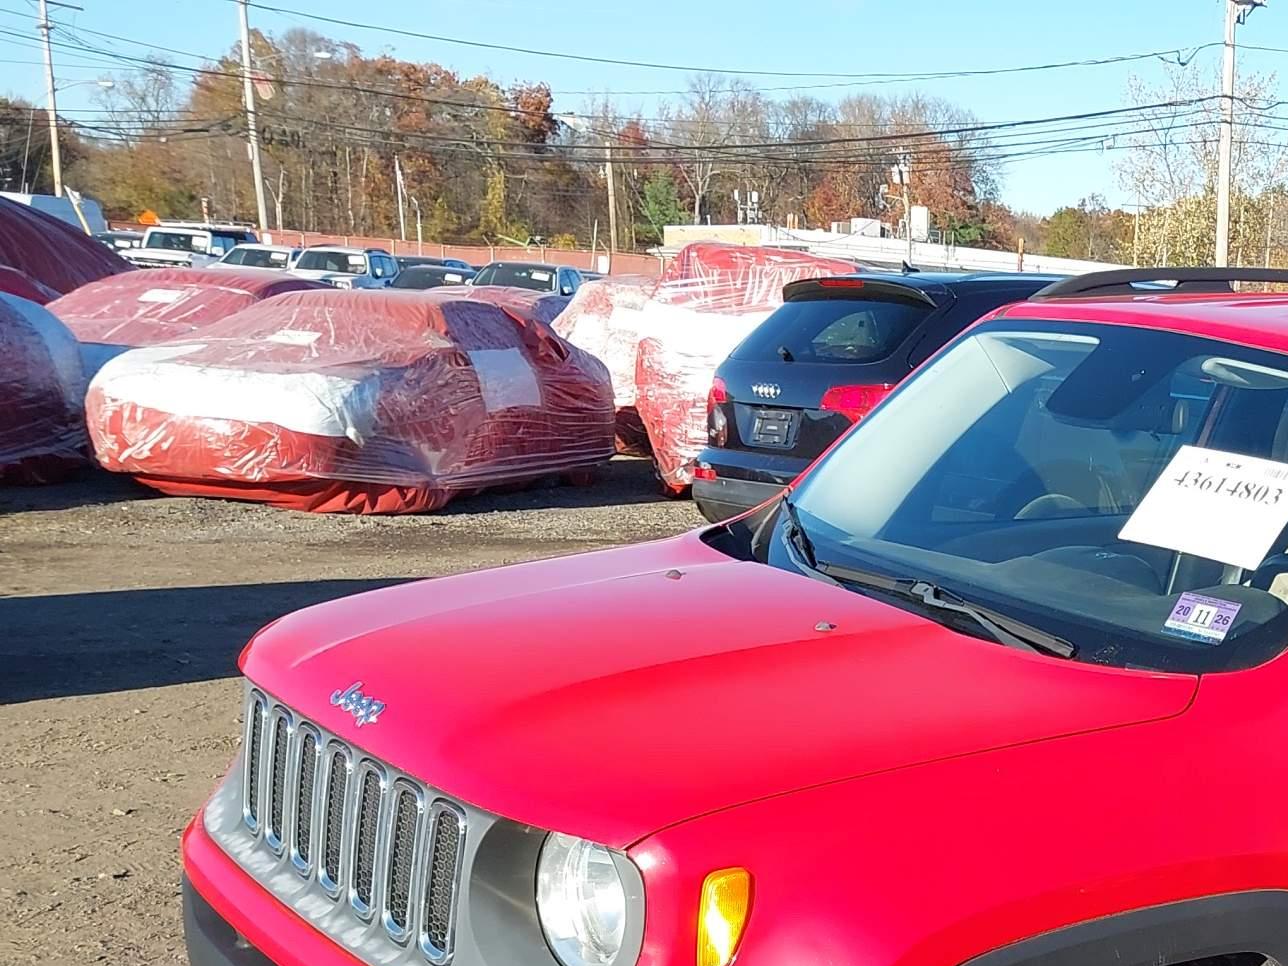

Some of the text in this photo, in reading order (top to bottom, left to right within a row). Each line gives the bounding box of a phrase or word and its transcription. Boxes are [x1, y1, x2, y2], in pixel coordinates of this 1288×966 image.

[1174, 470, 1284, 505] 43614803
[1175, 605, 1231, 626] 20 11 26
[330, 680, 386, 728] Jeep
